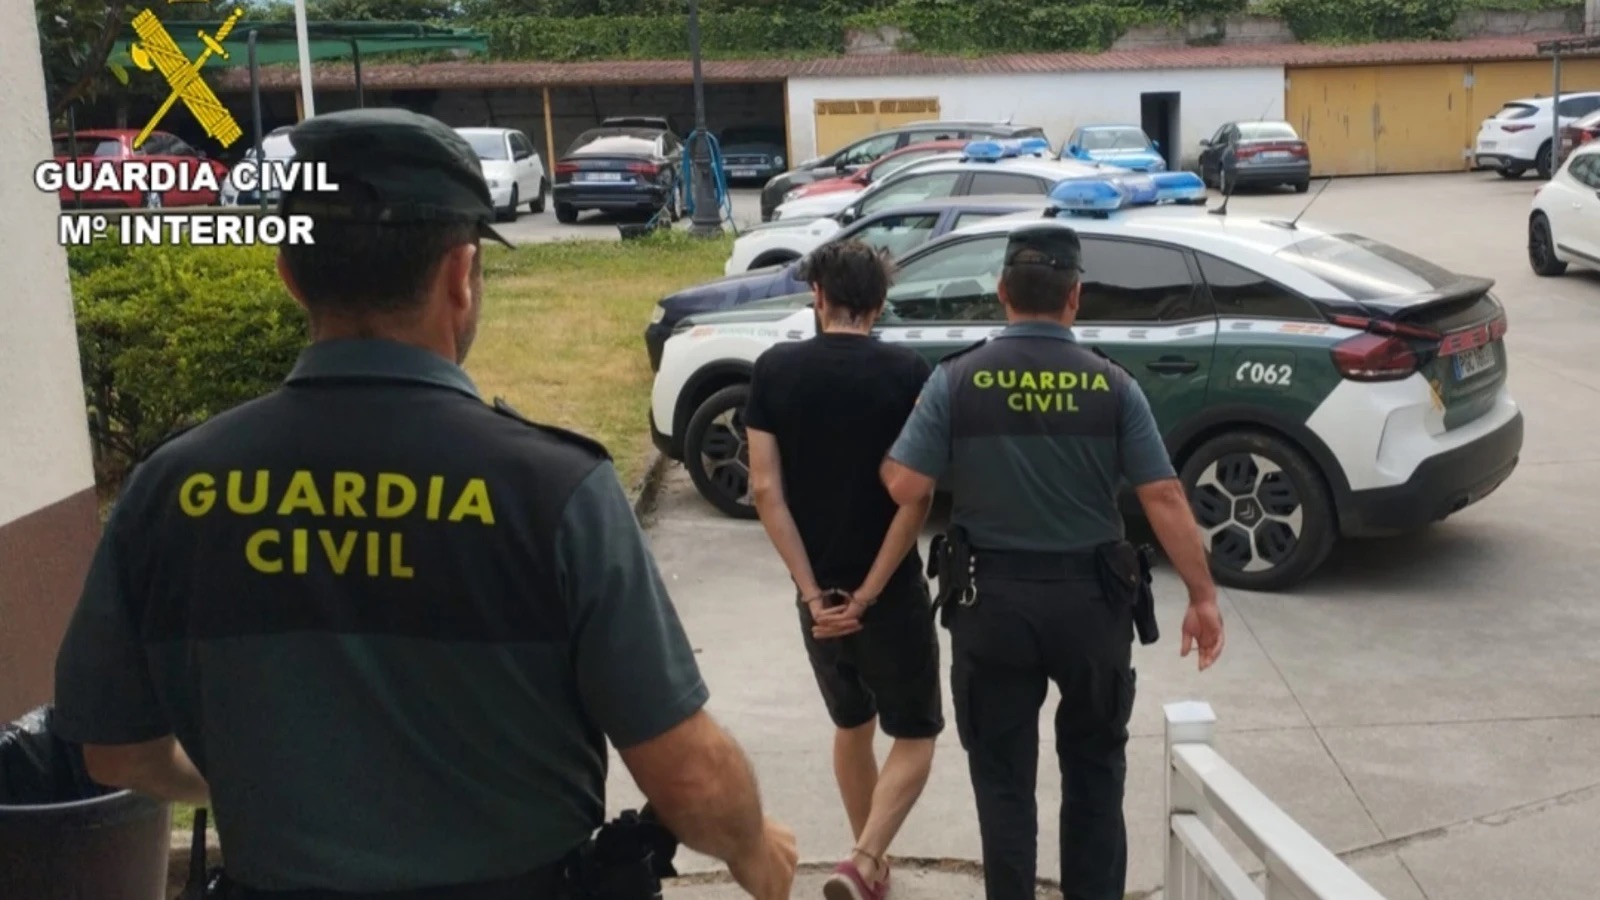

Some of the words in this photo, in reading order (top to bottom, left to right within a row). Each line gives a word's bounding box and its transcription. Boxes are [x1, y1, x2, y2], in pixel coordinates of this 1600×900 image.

[973, 370, 1110, 391] GUARDIA
[1250, 364, 1293, 385] 062
[1007, 393, 1079, 411] CIVIL
[179, 470, 495, 525] GUARDIA
[245, 528, 414, 578] CIVIL
